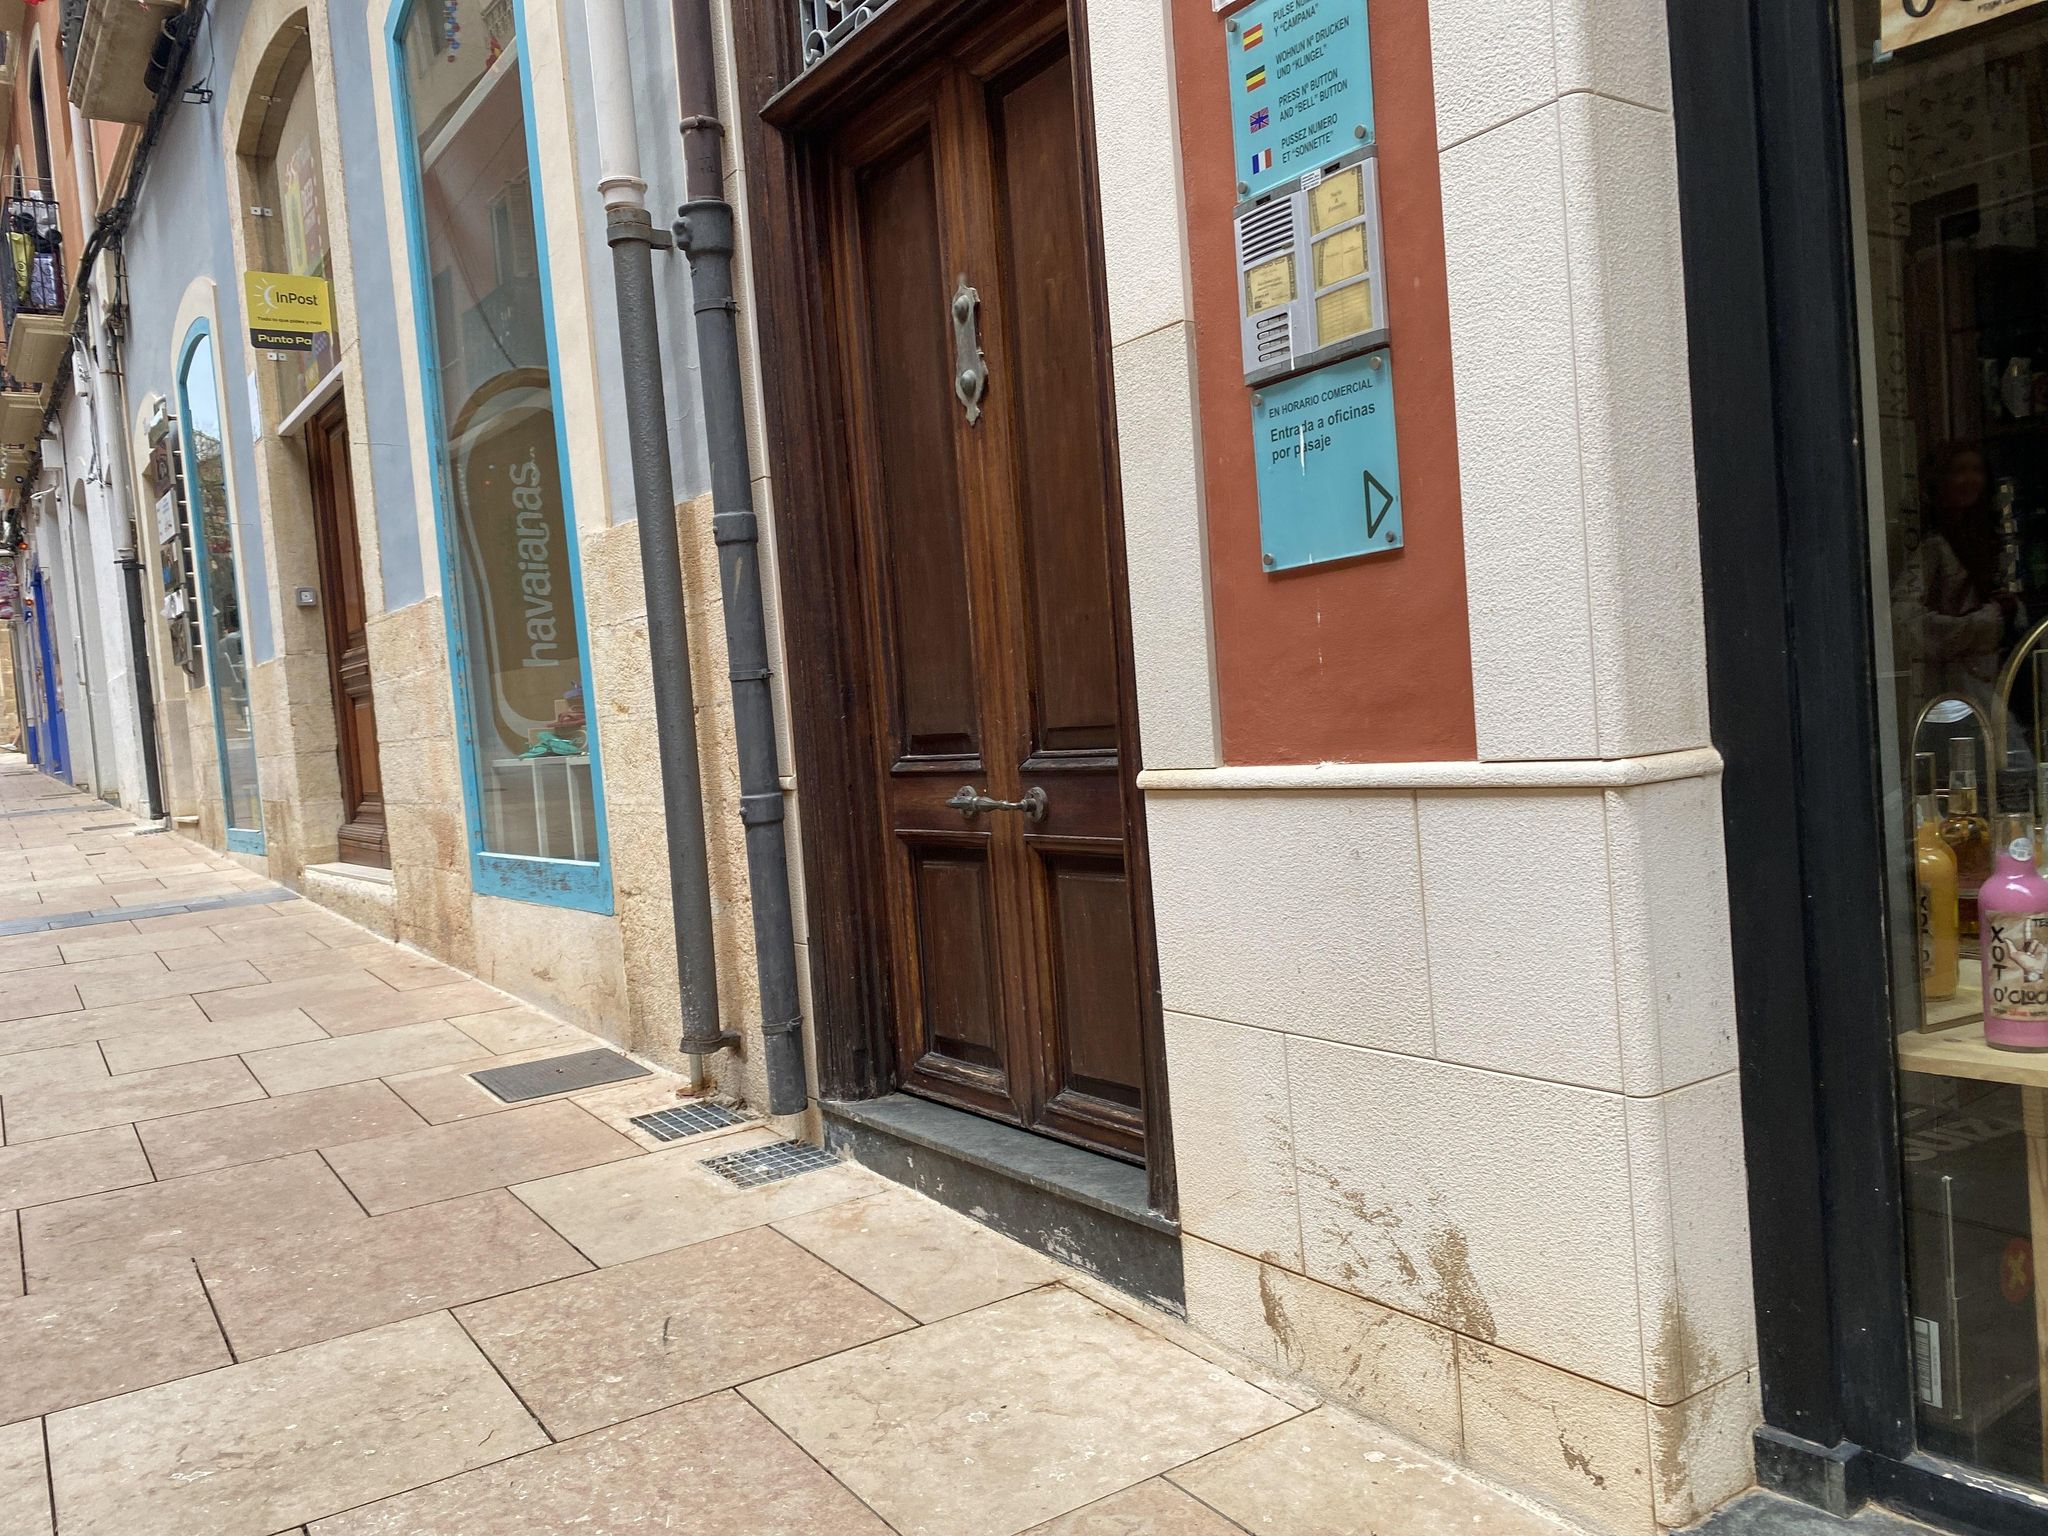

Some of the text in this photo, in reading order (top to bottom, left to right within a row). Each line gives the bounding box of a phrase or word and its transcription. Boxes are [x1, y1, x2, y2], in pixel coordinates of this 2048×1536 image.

[1273, 2, 1295, 22] PULSE
[1273, 26, 1279, 37] Y
[1275, 40, 1305, 64] WOHNUN
[1315, 15, 1350, 43] DRUCKEN
[1276, 64, 1291, 79] UND
[1279, 88, 1300, 107] PRESS
[1310, 68, 1338, 91] BUTTON
[1280, 106, 1294, 122] AND
[1319, 79, 1348, 102] BUTTON
[1281, 113, 1338, 149] PUSSEZ NUMERO
[1282, 151, 1291, 163] ET
[276, 291, 318, 306] InPost
[257, 334, 294, 344] Punto
[1269, 378, 1373, 419] EN HORARIO COMERCIAL
[1270, 403, 1376, 442] Entrada a oficinas
[1272, 434, 1331, 464] por pasaje
[509, 461, 560, 667] havaianas
